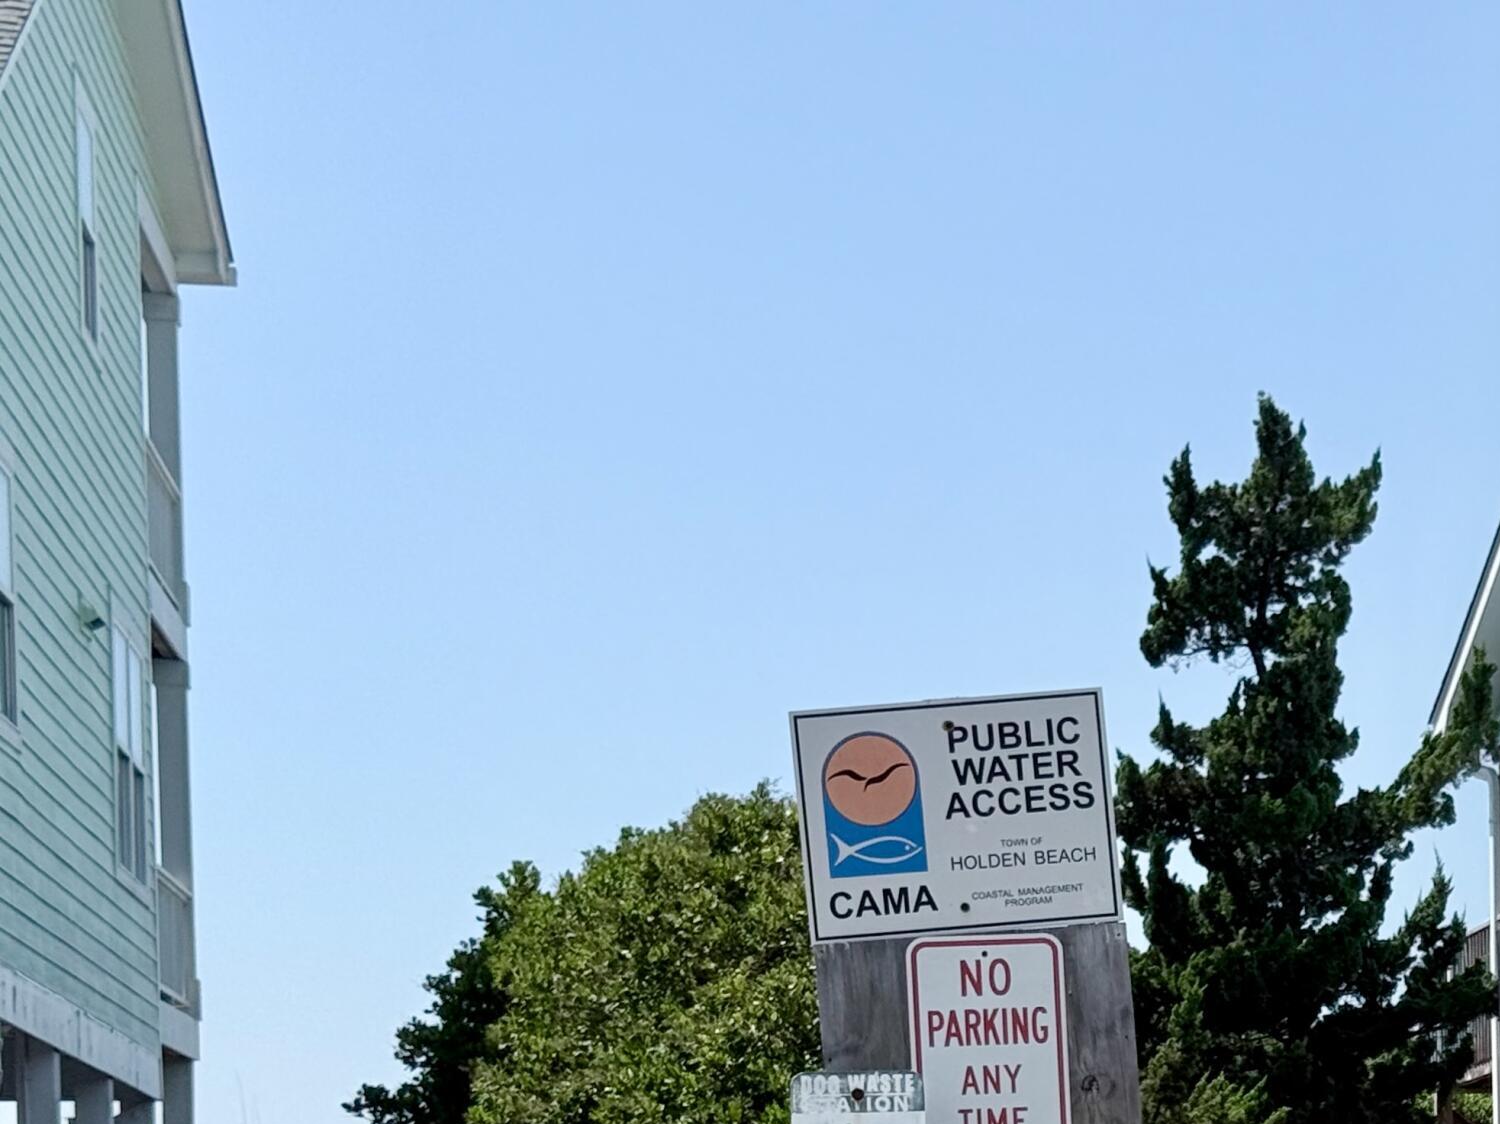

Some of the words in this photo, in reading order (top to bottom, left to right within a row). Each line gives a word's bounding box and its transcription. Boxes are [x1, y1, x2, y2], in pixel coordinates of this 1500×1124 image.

[947, 716, 1081, 753] PUBLIC
[952, 750, 1082, 786] WATER
[945, 781, 1096, 820] ACCESS
[1000, 838, 1029, 847] TOWN
[1030, 836, 1043, 846] OF
[950, 851, 1026, 871] HOLDEN
[1034, 847, 1097, 866] BEACH
[829, 884, 939, 920] CAMA
[971, 889, 1014, 900] COASTAL
[1017, 883, 1084, 897] MANAGEMENT
[1004, 896, 1053, 907] PROGRAM
[959, 957, 1012, 997] NO
[926, 1006, 1049, 1048] PARKING
[847, 1072, 915, 1093] WASTE
[961, 1064, 1023, 1095] ANY
